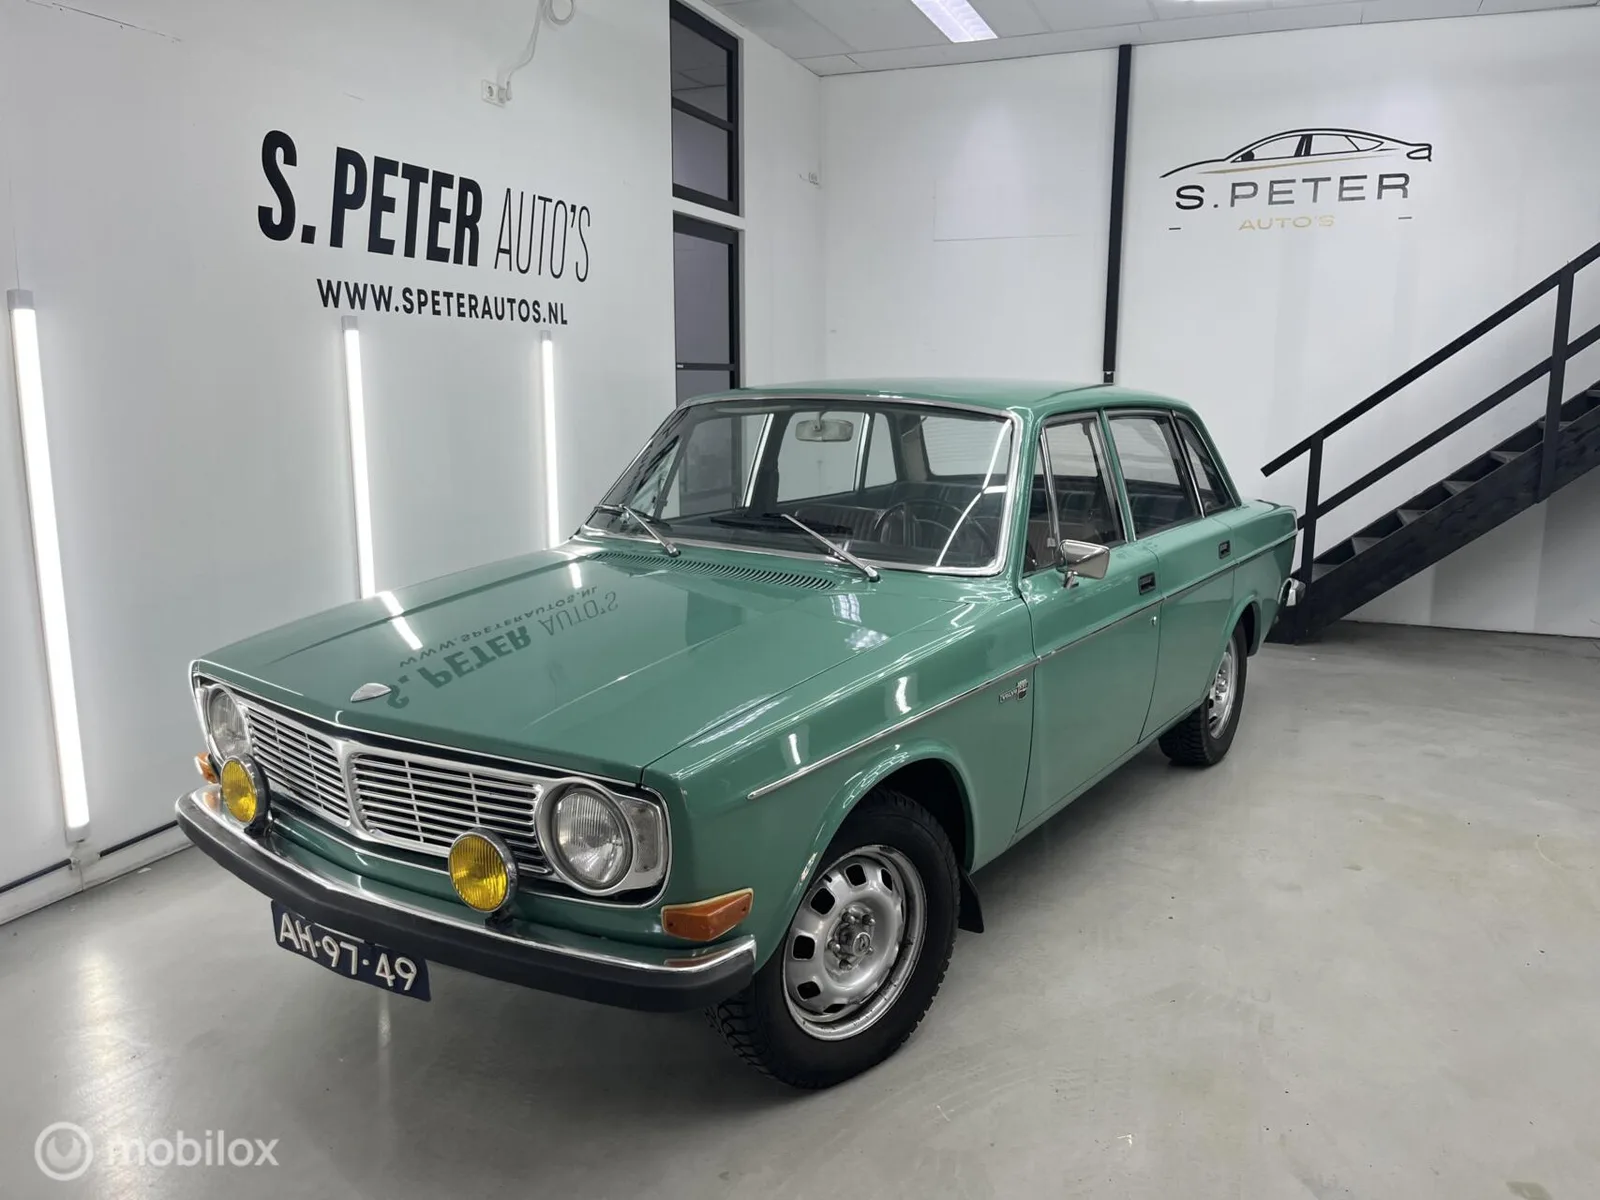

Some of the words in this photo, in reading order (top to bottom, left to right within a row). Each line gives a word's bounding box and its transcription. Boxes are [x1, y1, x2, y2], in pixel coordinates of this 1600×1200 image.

[257, 129, 316, 244] S.
[329, 146, 483, 267] PETER
[494, 187, 591, 282] AUTO'S
[1239, 215, 1335, 231] AUTO'S
[316, 278, 568, 325] WWW.SPETERAUTOS.NL
